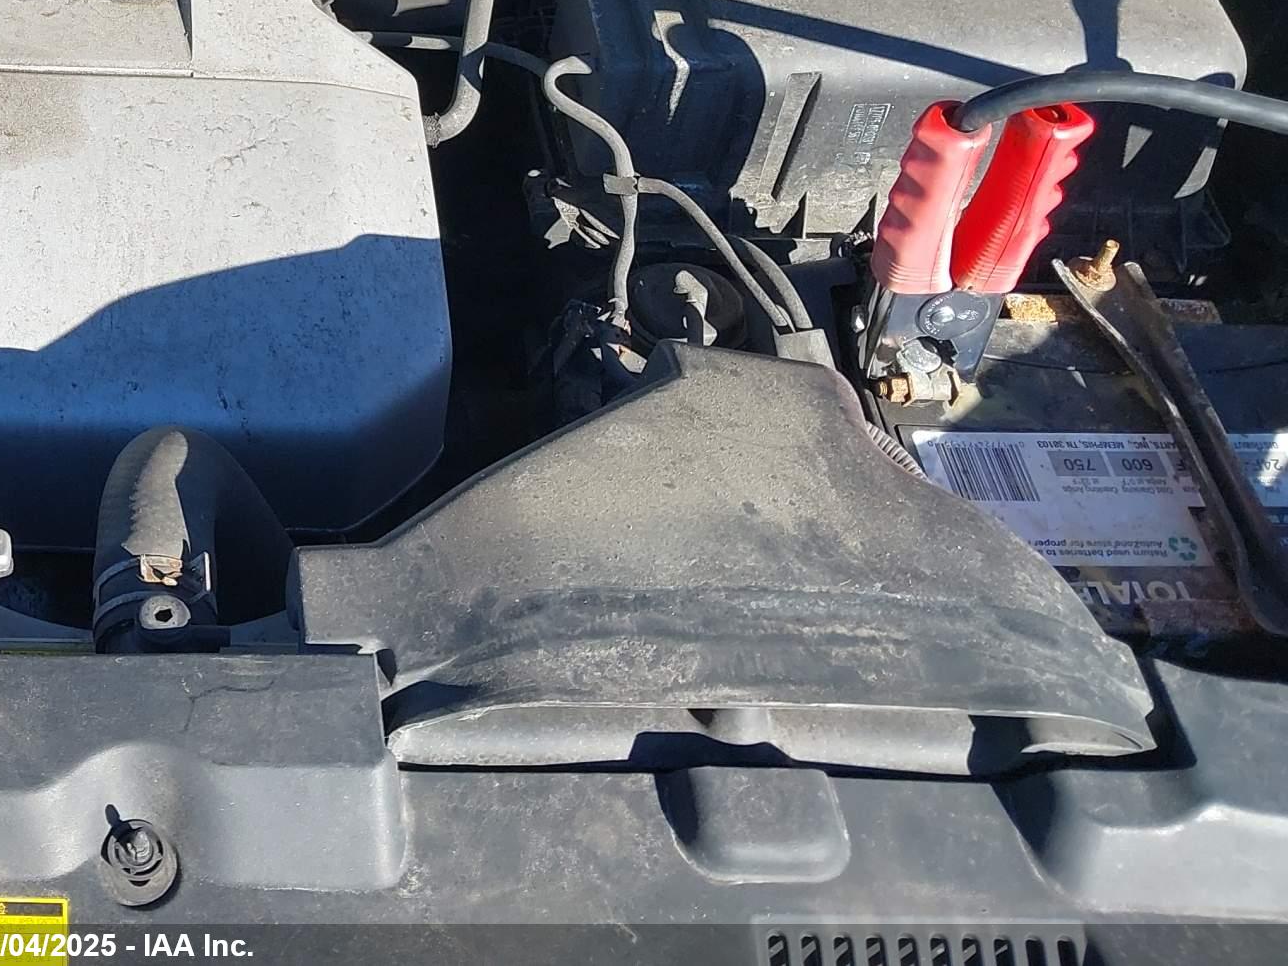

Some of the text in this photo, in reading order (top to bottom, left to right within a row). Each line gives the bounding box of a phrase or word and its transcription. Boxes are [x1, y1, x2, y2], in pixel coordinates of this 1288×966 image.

[1036, 440, 1065, 450] 38103
[1065, 440, 1078, 450] TN
[1078, 439, 1124, 450] MEMPHIS,
[1063, 458, 1097, 472] 750
[1121, 458, 1154, 472] 600
[1033, 538, 1066, 548] proper
